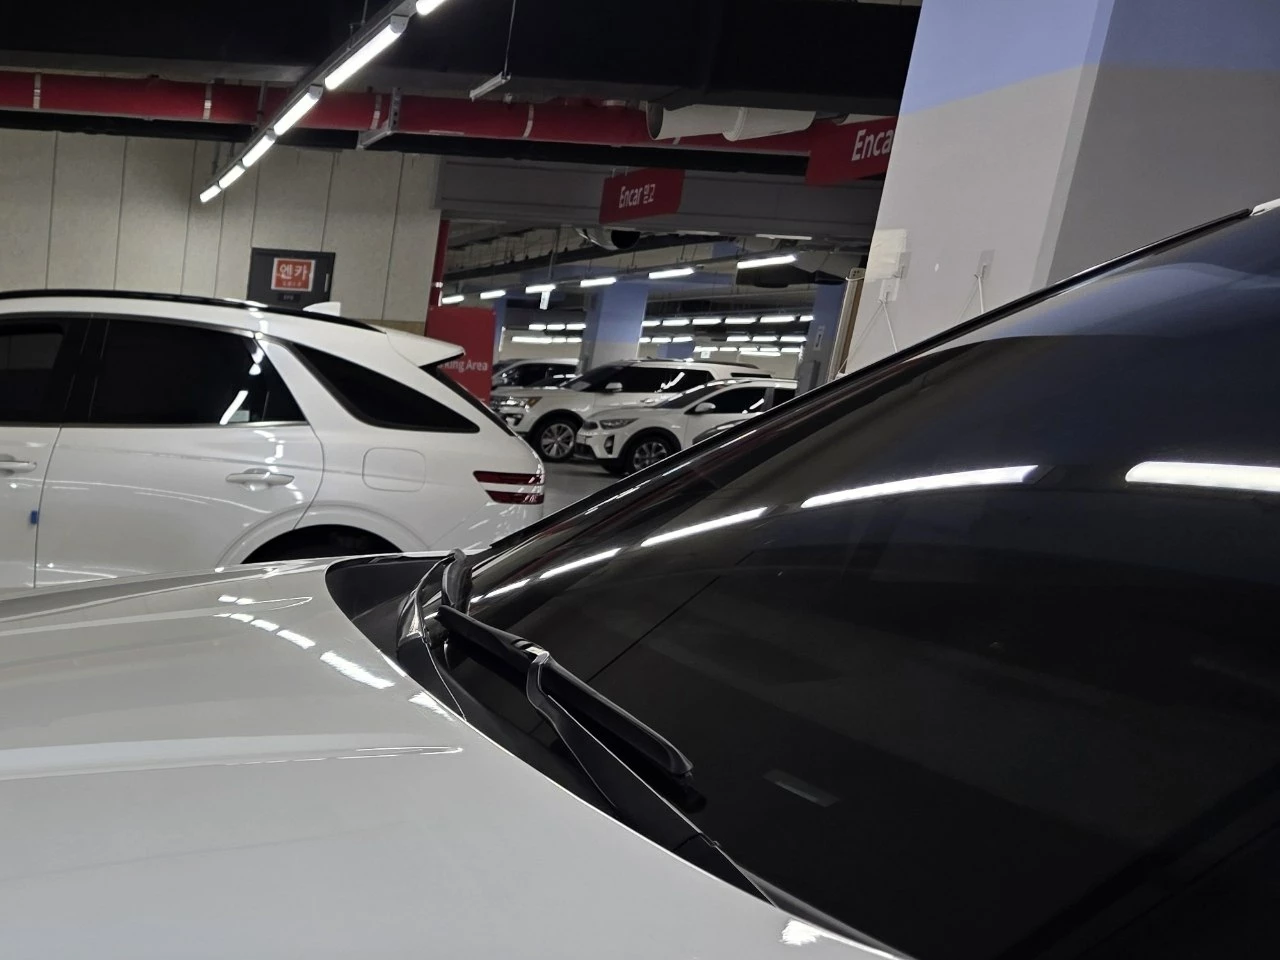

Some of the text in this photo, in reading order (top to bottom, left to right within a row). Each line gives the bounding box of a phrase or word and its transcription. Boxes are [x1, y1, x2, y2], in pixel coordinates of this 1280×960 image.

[618, 185, 643, 209] Encar
[279, 263, 308, 281] 엔카
[465, 360, 488, 371] Area
